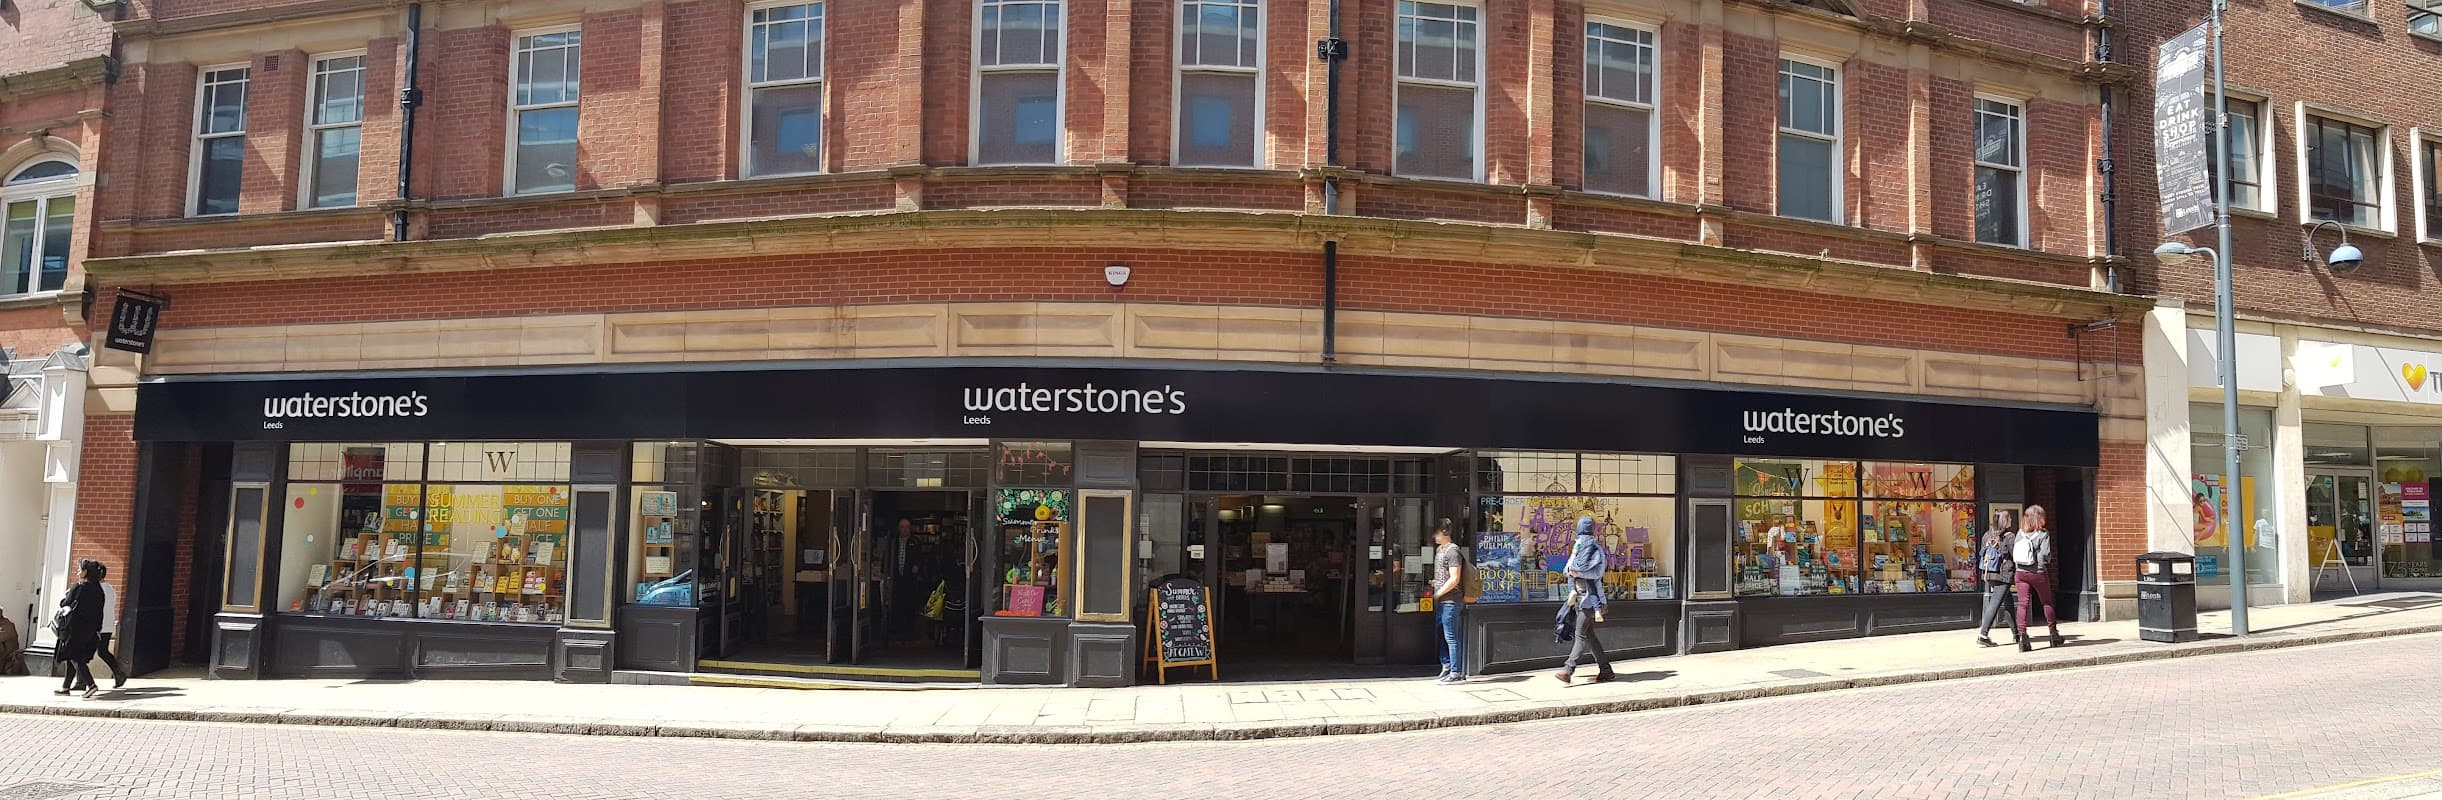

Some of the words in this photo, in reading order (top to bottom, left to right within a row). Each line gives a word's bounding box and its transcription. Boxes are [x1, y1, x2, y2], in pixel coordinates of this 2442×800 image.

[2167, 100, 2191, 116] EAT
[2160, 108, 2199, 130] DRINK
[2162, 121, 2196, 139] SHOP
[263, 390, 428, 418] waterstone's
[963, 382, 1187, 415] waterstone's
[263, 421, 284, 430] Leeds
[963, 415, 991, 425] Leeds
[1743, 407, 1905, 438] waterstone's
[1743, 435, 1765, 444] Leeds
[485, 451, 516, 473] W
[1784, 468, 1810, 489] W
[1907, 471, 1932, 491] W
[396, 495, 415, 504] BUY
[430, 493, 500, 509] SUMMER
[513, 494, 534, 504] BUY
[537, 494, 561, 505] ONE
[1480, 497, 1525, 506] PRE-ORDER
[429, 508, 501, 524] READING
[535, 507, 560, 518] ONE
[399, 533, 433, 545] PRIE
[1483, 535, 1509, 543] PHILIP
[1479, 569, 1514, 580] BOOK
[1165, 582, 1197, 596] Summer
